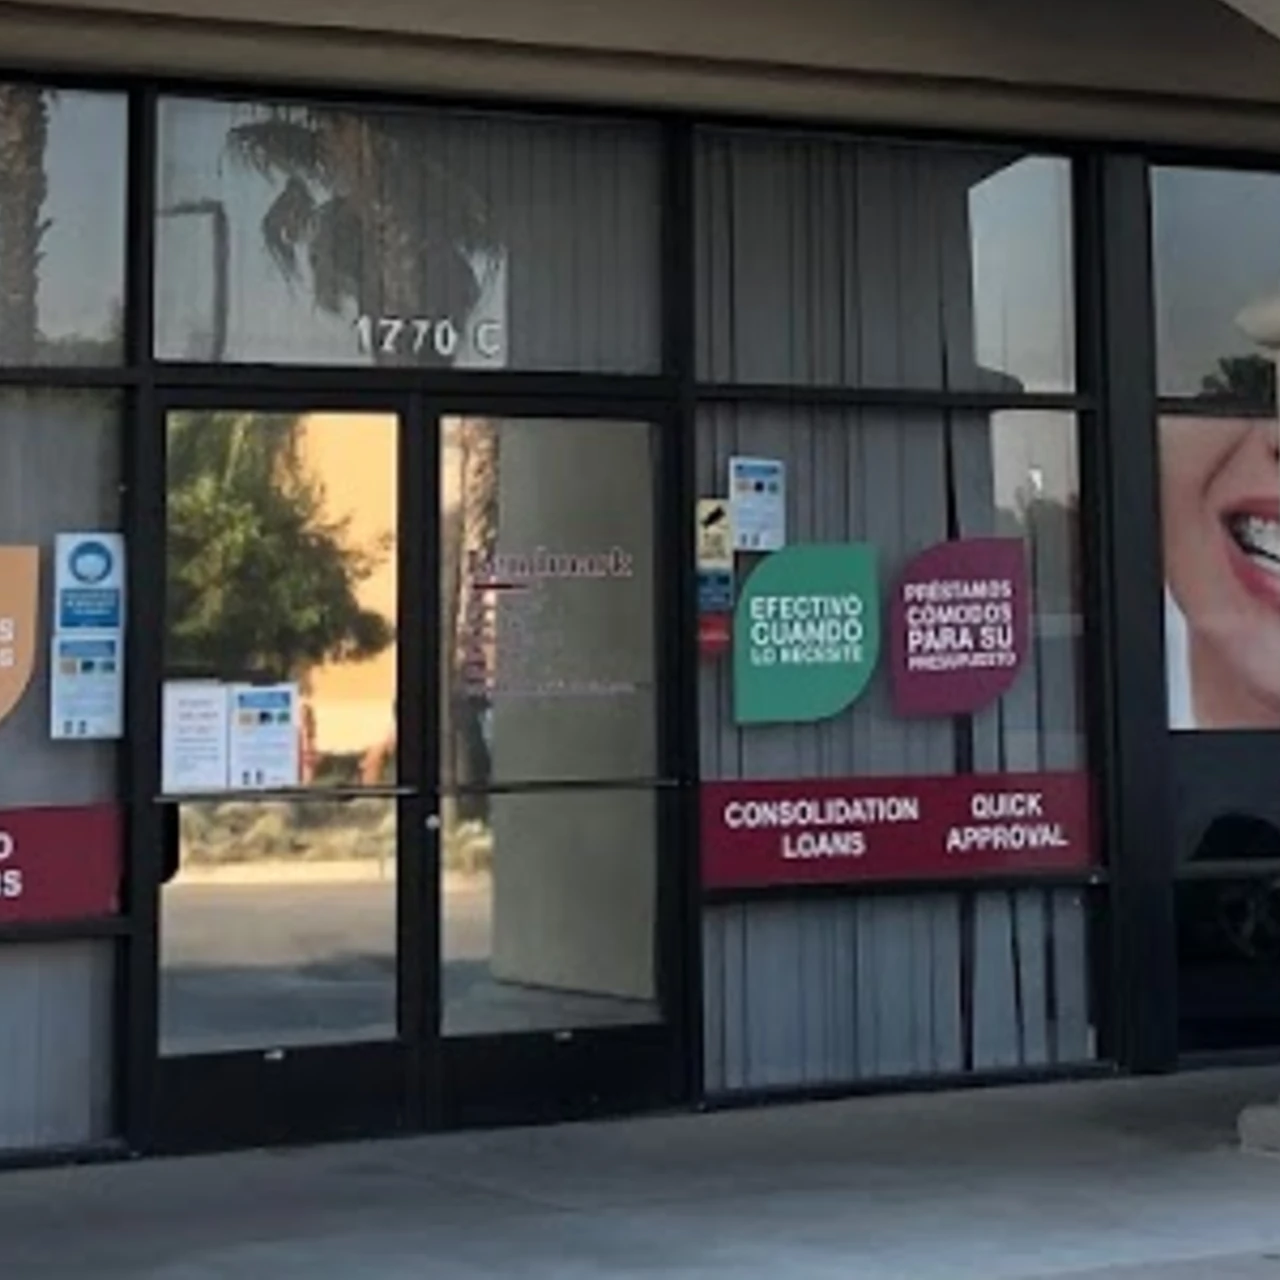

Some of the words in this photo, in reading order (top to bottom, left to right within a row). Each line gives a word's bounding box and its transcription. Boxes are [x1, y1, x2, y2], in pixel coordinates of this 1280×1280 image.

[357, 315, 458, 356] 1770
[476, 322, 502, 356] C
[750, 594, 862, 619] EFECTIVO
[750, 620, 863, 645] CUANDO
[908, 626, 974, 653] PARA
[980, 624, 1013, 650] SU
[751, 646, 777, 666] LO
[724, 796, 920, 828] CONSOLIDATION
[971, 792, 1043, 819] QUICK
[782, 830, 866, 860] LOANS
[946, 824, 1068, 853] APPROVAL
